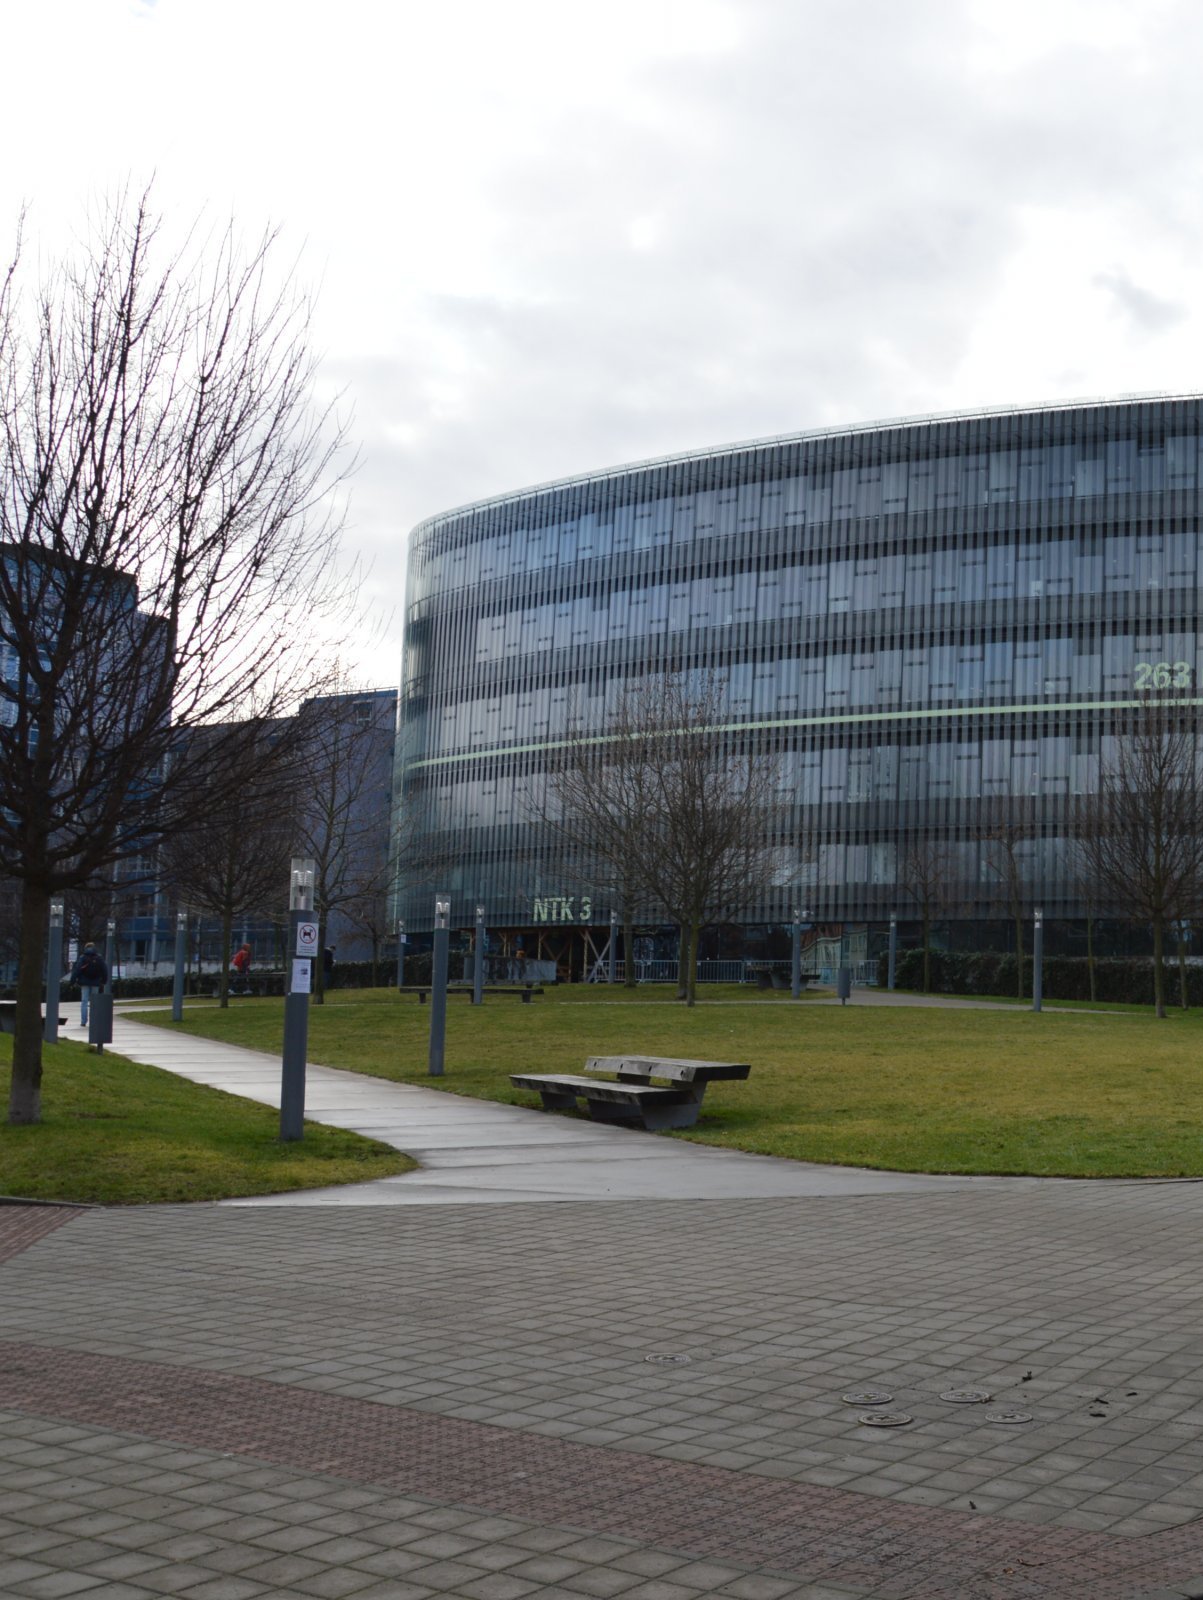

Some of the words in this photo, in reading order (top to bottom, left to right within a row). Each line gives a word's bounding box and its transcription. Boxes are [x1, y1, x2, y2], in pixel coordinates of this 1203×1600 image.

[1134, 661, 1191, 689] 263
[534, 896, 574, 922] NTK
[579, 896, 592, 921] 3
